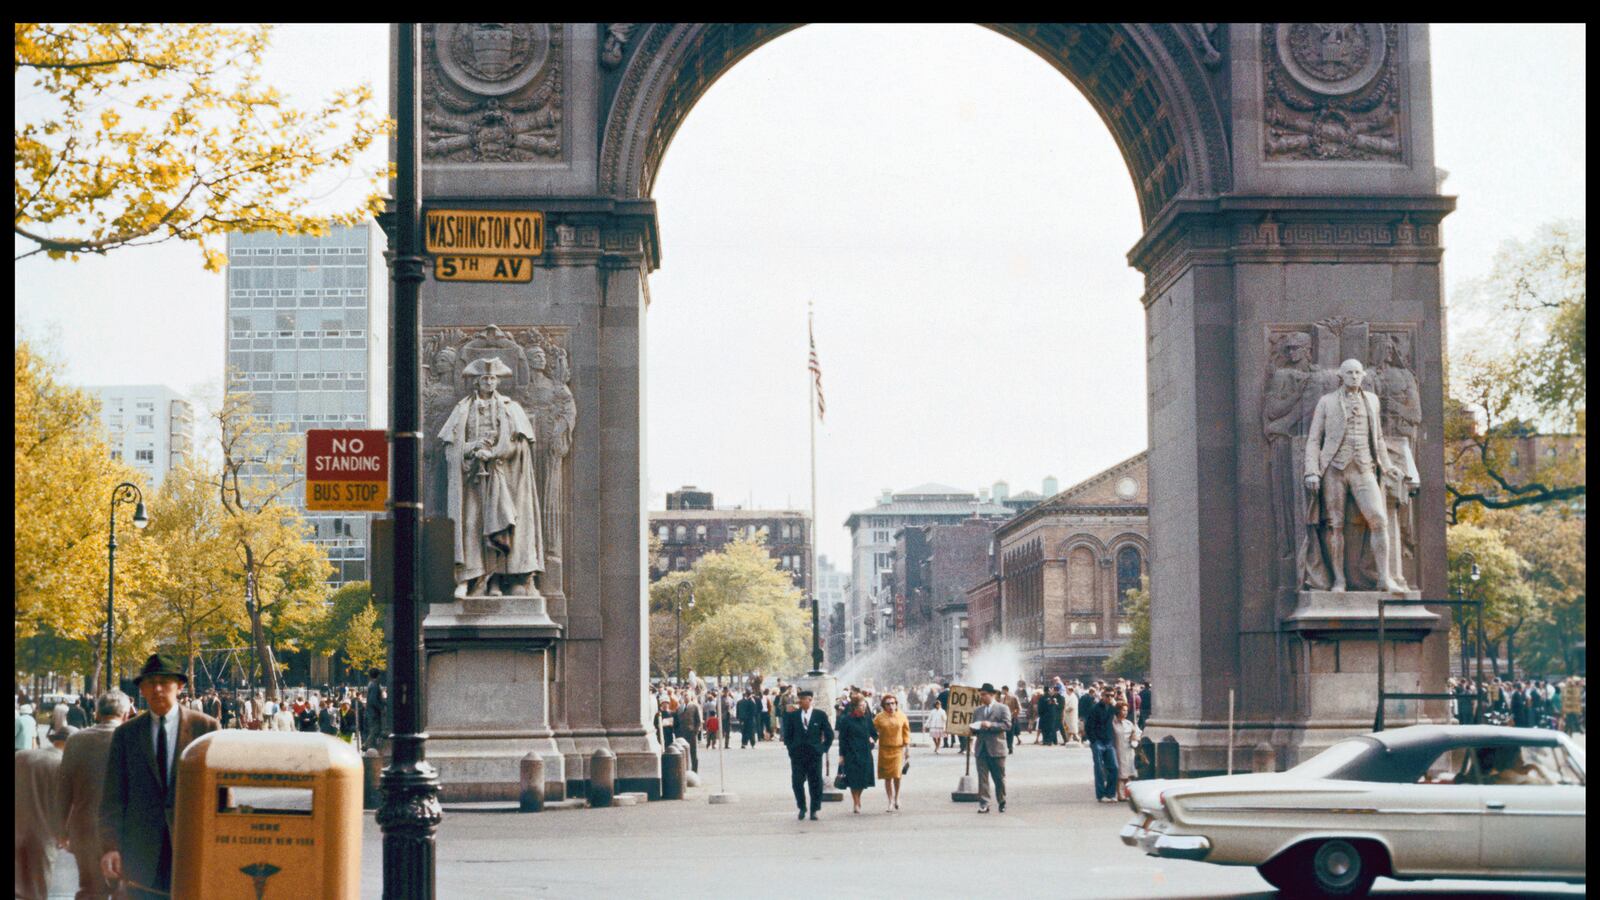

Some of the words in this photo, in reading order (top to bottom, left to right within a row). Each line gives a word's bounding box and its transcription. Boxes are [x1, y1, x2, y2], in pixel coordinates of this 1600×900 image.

[428, 215, 511, 249] WASHINGTON
[514, 217, 532, 250] SQ
[534, 217, 541, 249] N
[442, 258, 479, 277] 5TH
[494, 259, 522, 278] AV
[332, 438, 364, 454] NO
[315, 455, 380, 471] STANDING
[314, 484, 340, 501] BUS
[346, 484, 379, 501] STOP
[951, 692, 968, 706] DO
[951, 711, 973, 725] ENT
